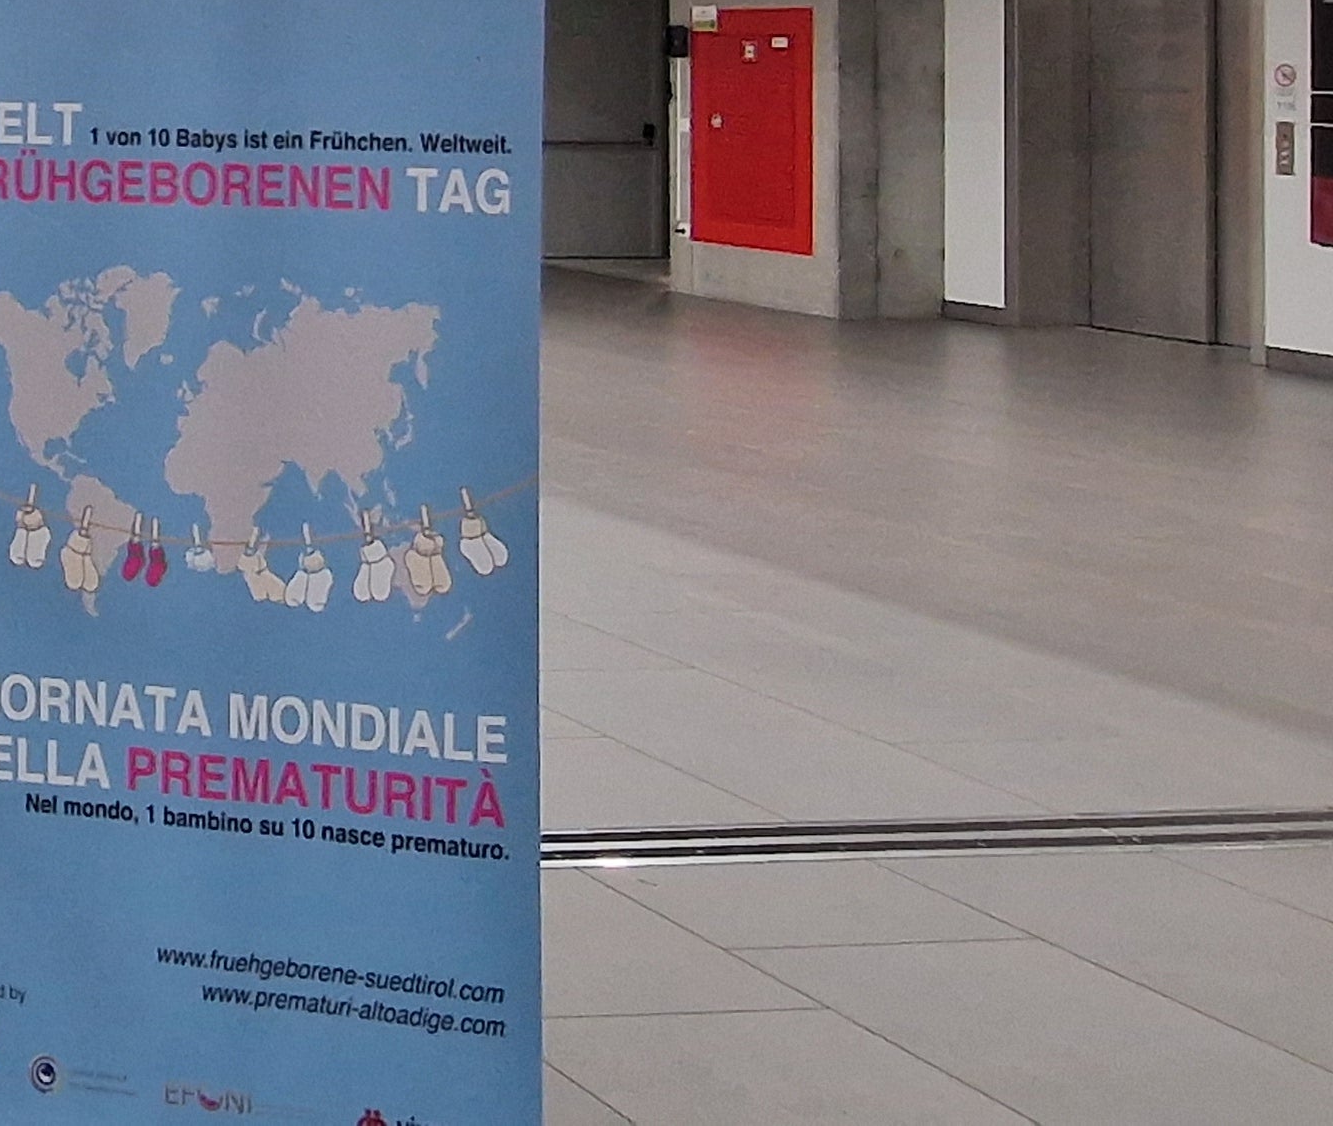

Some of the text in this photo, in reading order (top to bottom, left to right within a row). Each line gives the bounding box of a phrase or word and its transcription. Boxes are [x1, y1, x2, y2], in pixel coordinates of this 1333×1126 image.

[91, 128, 511, 154] 1 von 10 Babys ist ein Frühchen. Weltweit.
[406, 167, 510, 215] TAG
[228, 693, 507, 764] MONDIALE
[127, 747, 506, 828] PREMATURITÀ
[26, 793, 509, 860] Nel mondo, 1 bambino su 10 nasce prematuro.
[9, 985, 26, 1004] by
[157, 945, 505, 1003] www.fruehgeborene-suedtirol.com
[202, 983, 506, 1038] www.prematuri-altoadige.com
